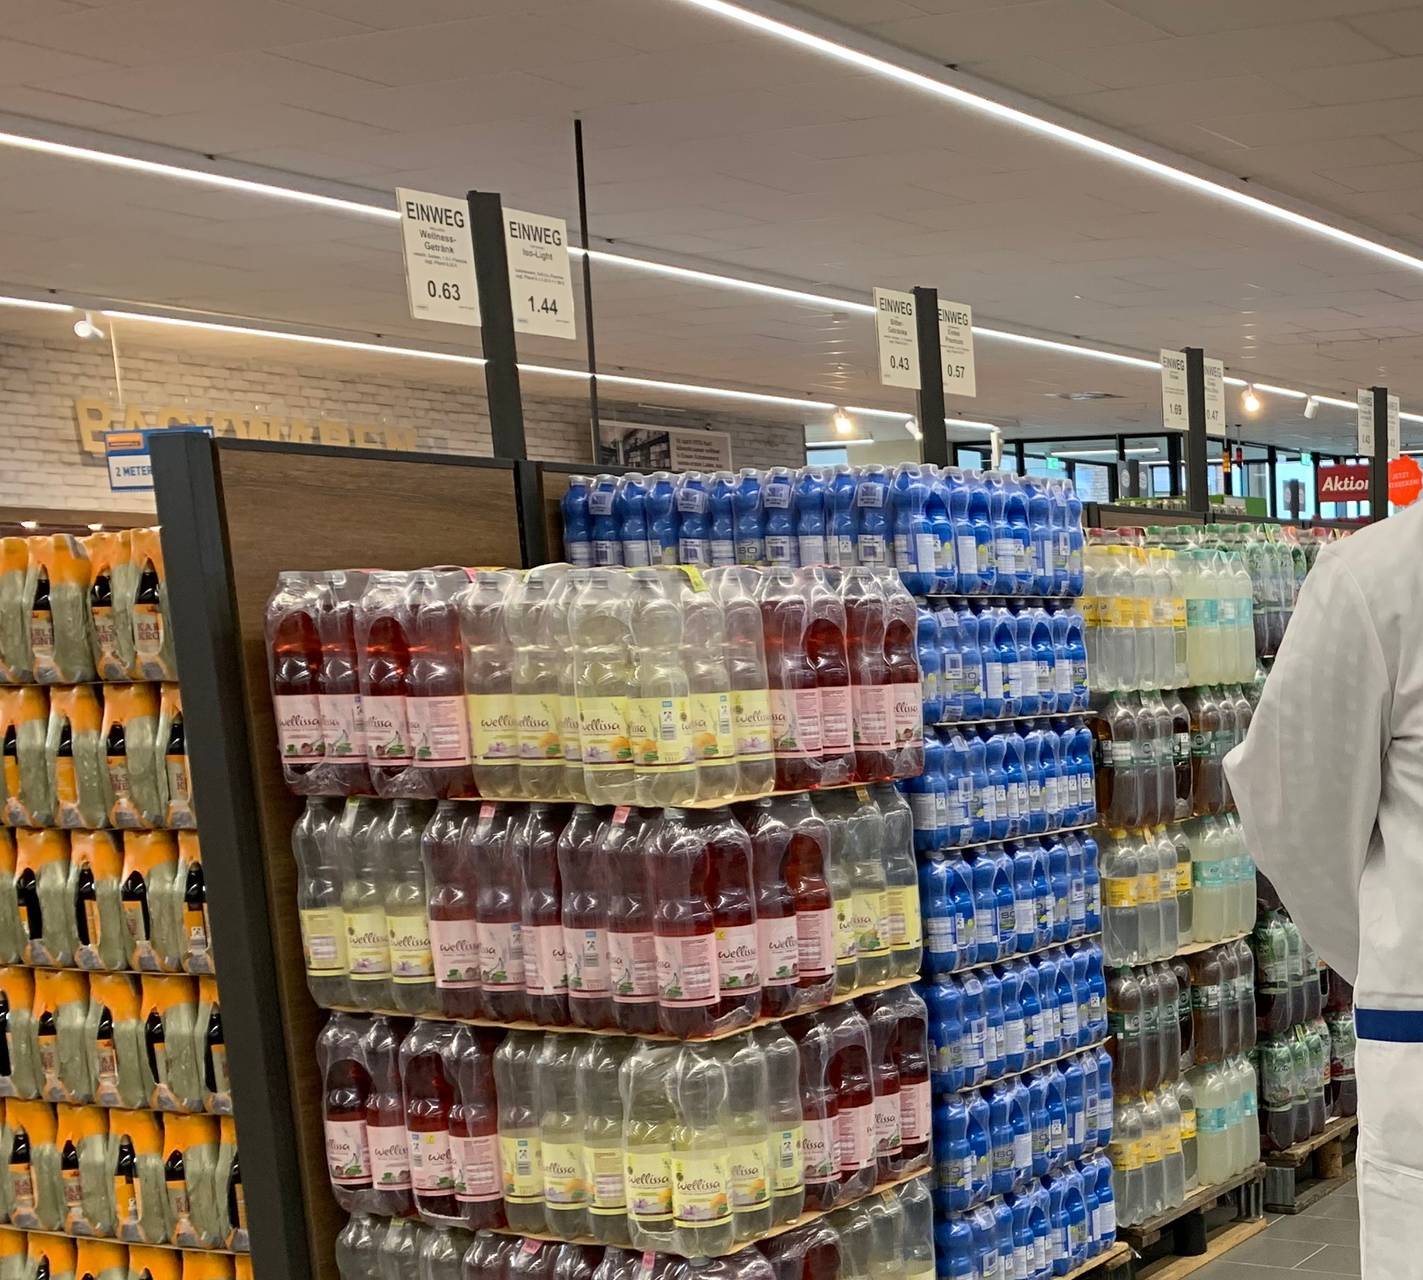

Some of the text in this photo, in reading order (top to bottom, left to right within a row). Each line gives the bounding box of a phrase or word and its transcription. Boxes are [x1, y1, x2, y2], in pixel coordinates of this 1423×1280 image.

[406, 201, 465, 229] EINWEG
[419, 229, 457, 246] Wellness-
[509, 220, 563, 247] EINWEG
[424, 241, 455, 254] Getränk
[427, 279, 462, 301] 0.63
[528, 295, 559, 316] 1.44
[879, 297, 913, 317] EINWEG
[938, 308, 969, 327] EINWEG
[890, 355, 910, 371] 0.43
[947, 364, 965, 379] 0.57
[1163, 356, 1185, 372] EINWEG
[115, 466, 121, 477] 2
[677, 1177, 721, 1192] wellissa
